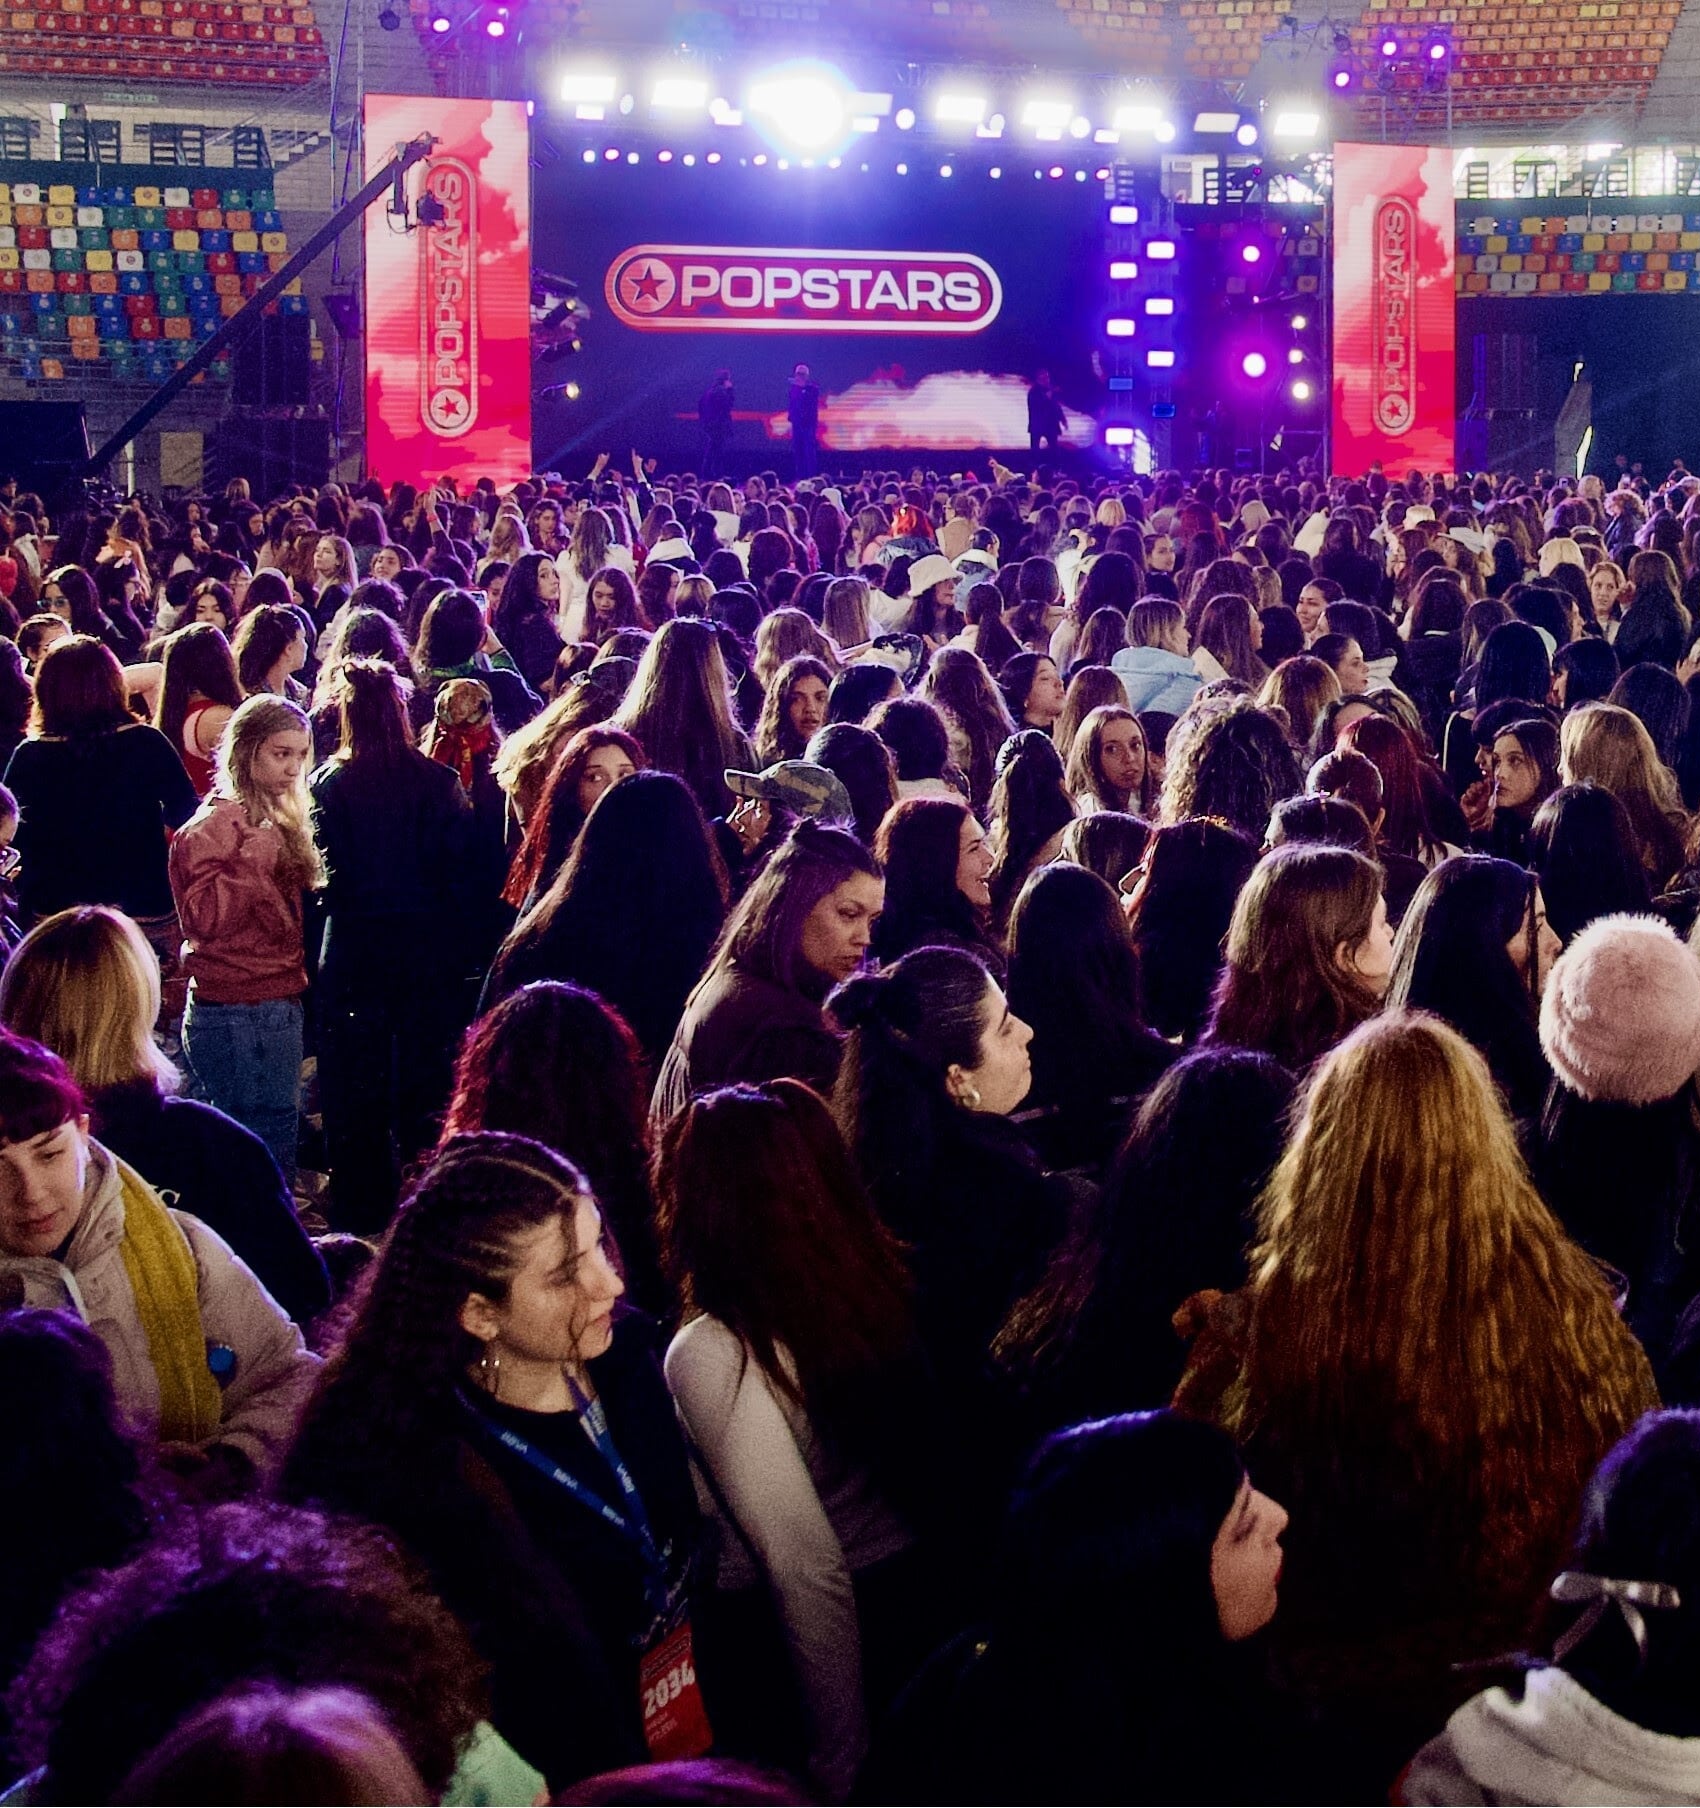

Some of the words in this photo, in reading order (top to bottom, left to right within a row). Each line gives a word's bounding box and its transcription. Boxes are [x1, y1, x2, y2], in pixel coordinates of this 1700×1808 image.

[434, 172, 465, 387] POPSTARS
[681, 265, 982, 312] POPSTARS
[1383, 209, 1407, 391] POPSTARS
[643, 1659, 696, 1719] 2034
